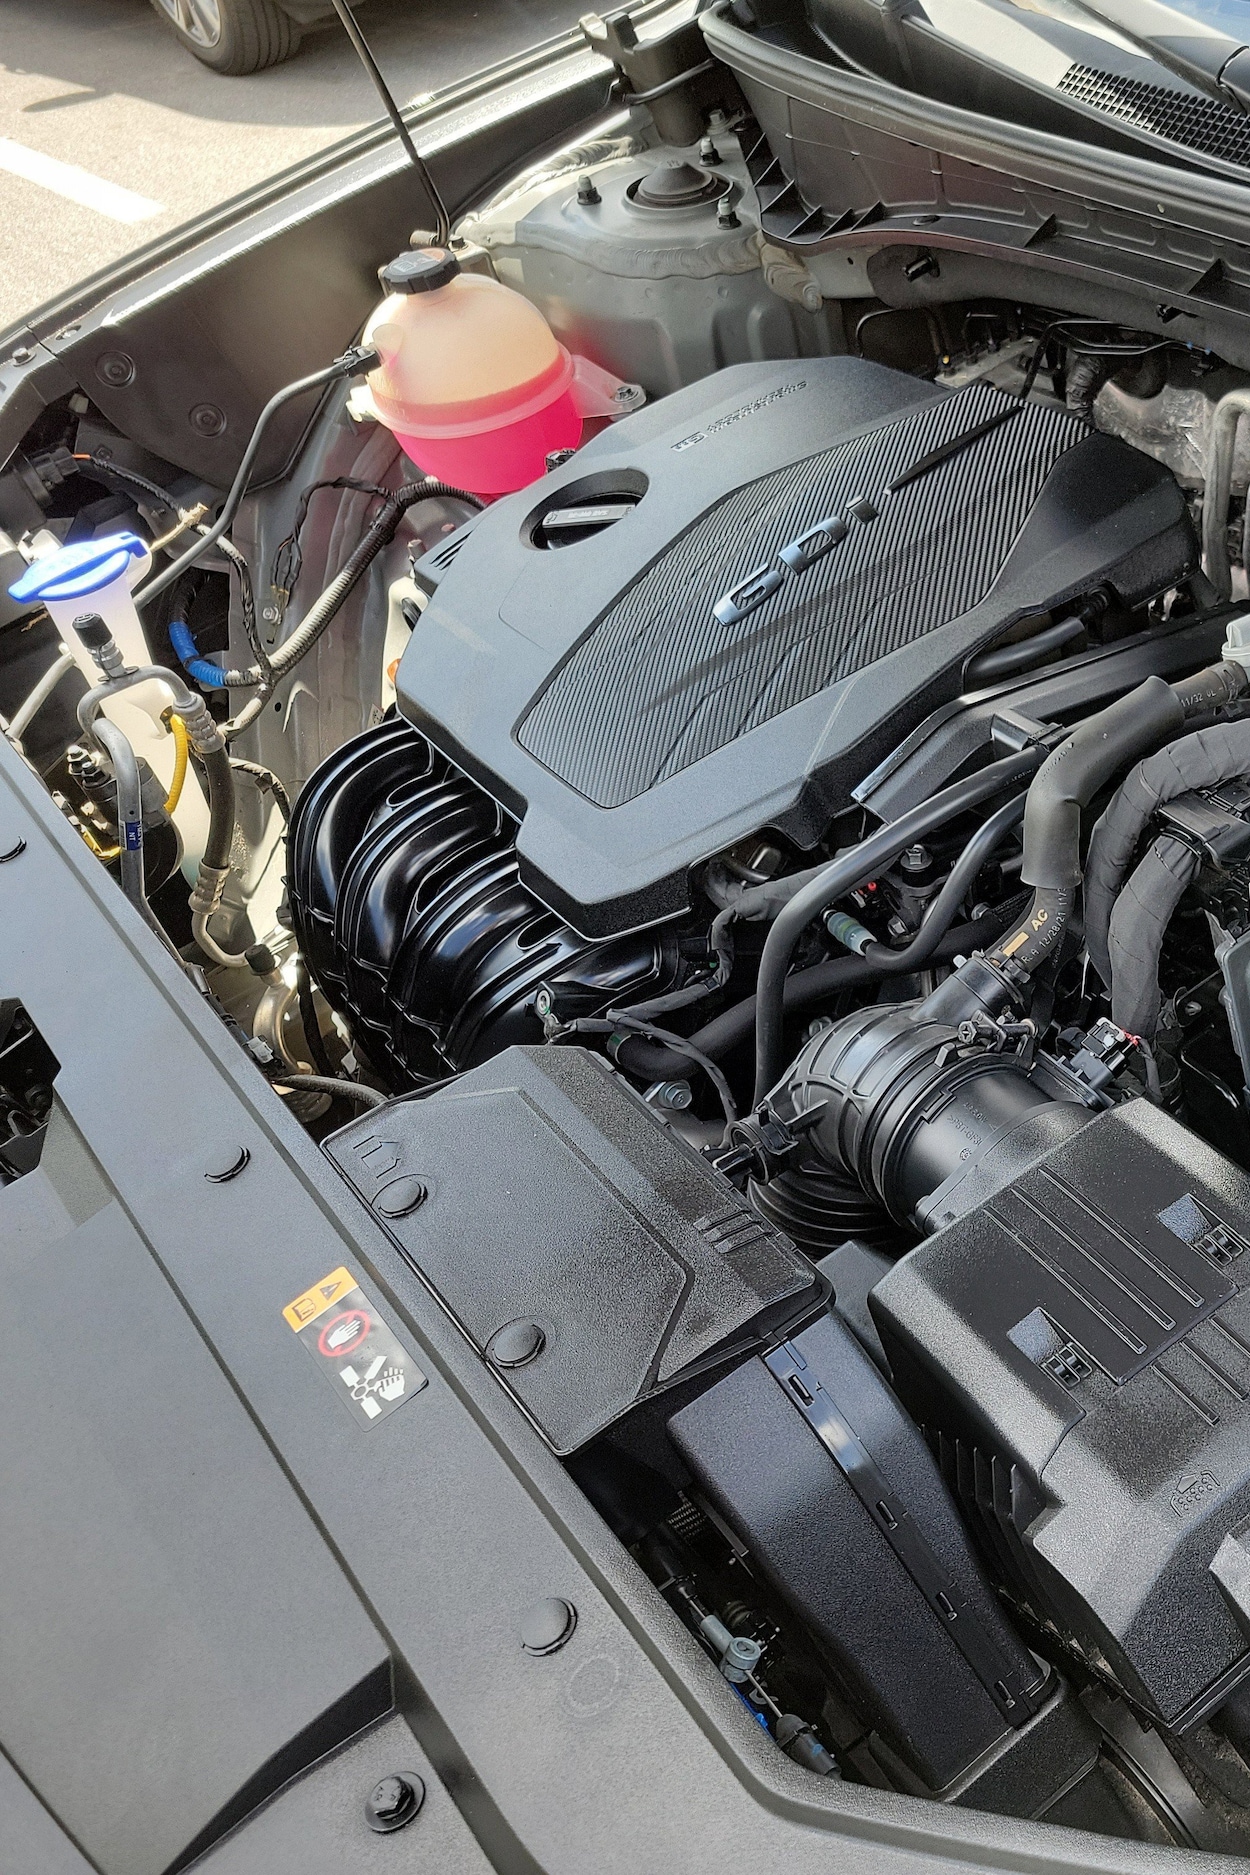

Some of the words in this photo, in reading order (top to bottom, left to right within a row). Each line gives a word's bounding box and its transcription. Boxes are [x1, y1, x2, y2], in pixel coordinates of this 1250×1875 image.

[128, 831, 135, 841] NT
[1031, 909, 1049, 931] AC
[1038, 910, 1066, 948] 12/28/21
